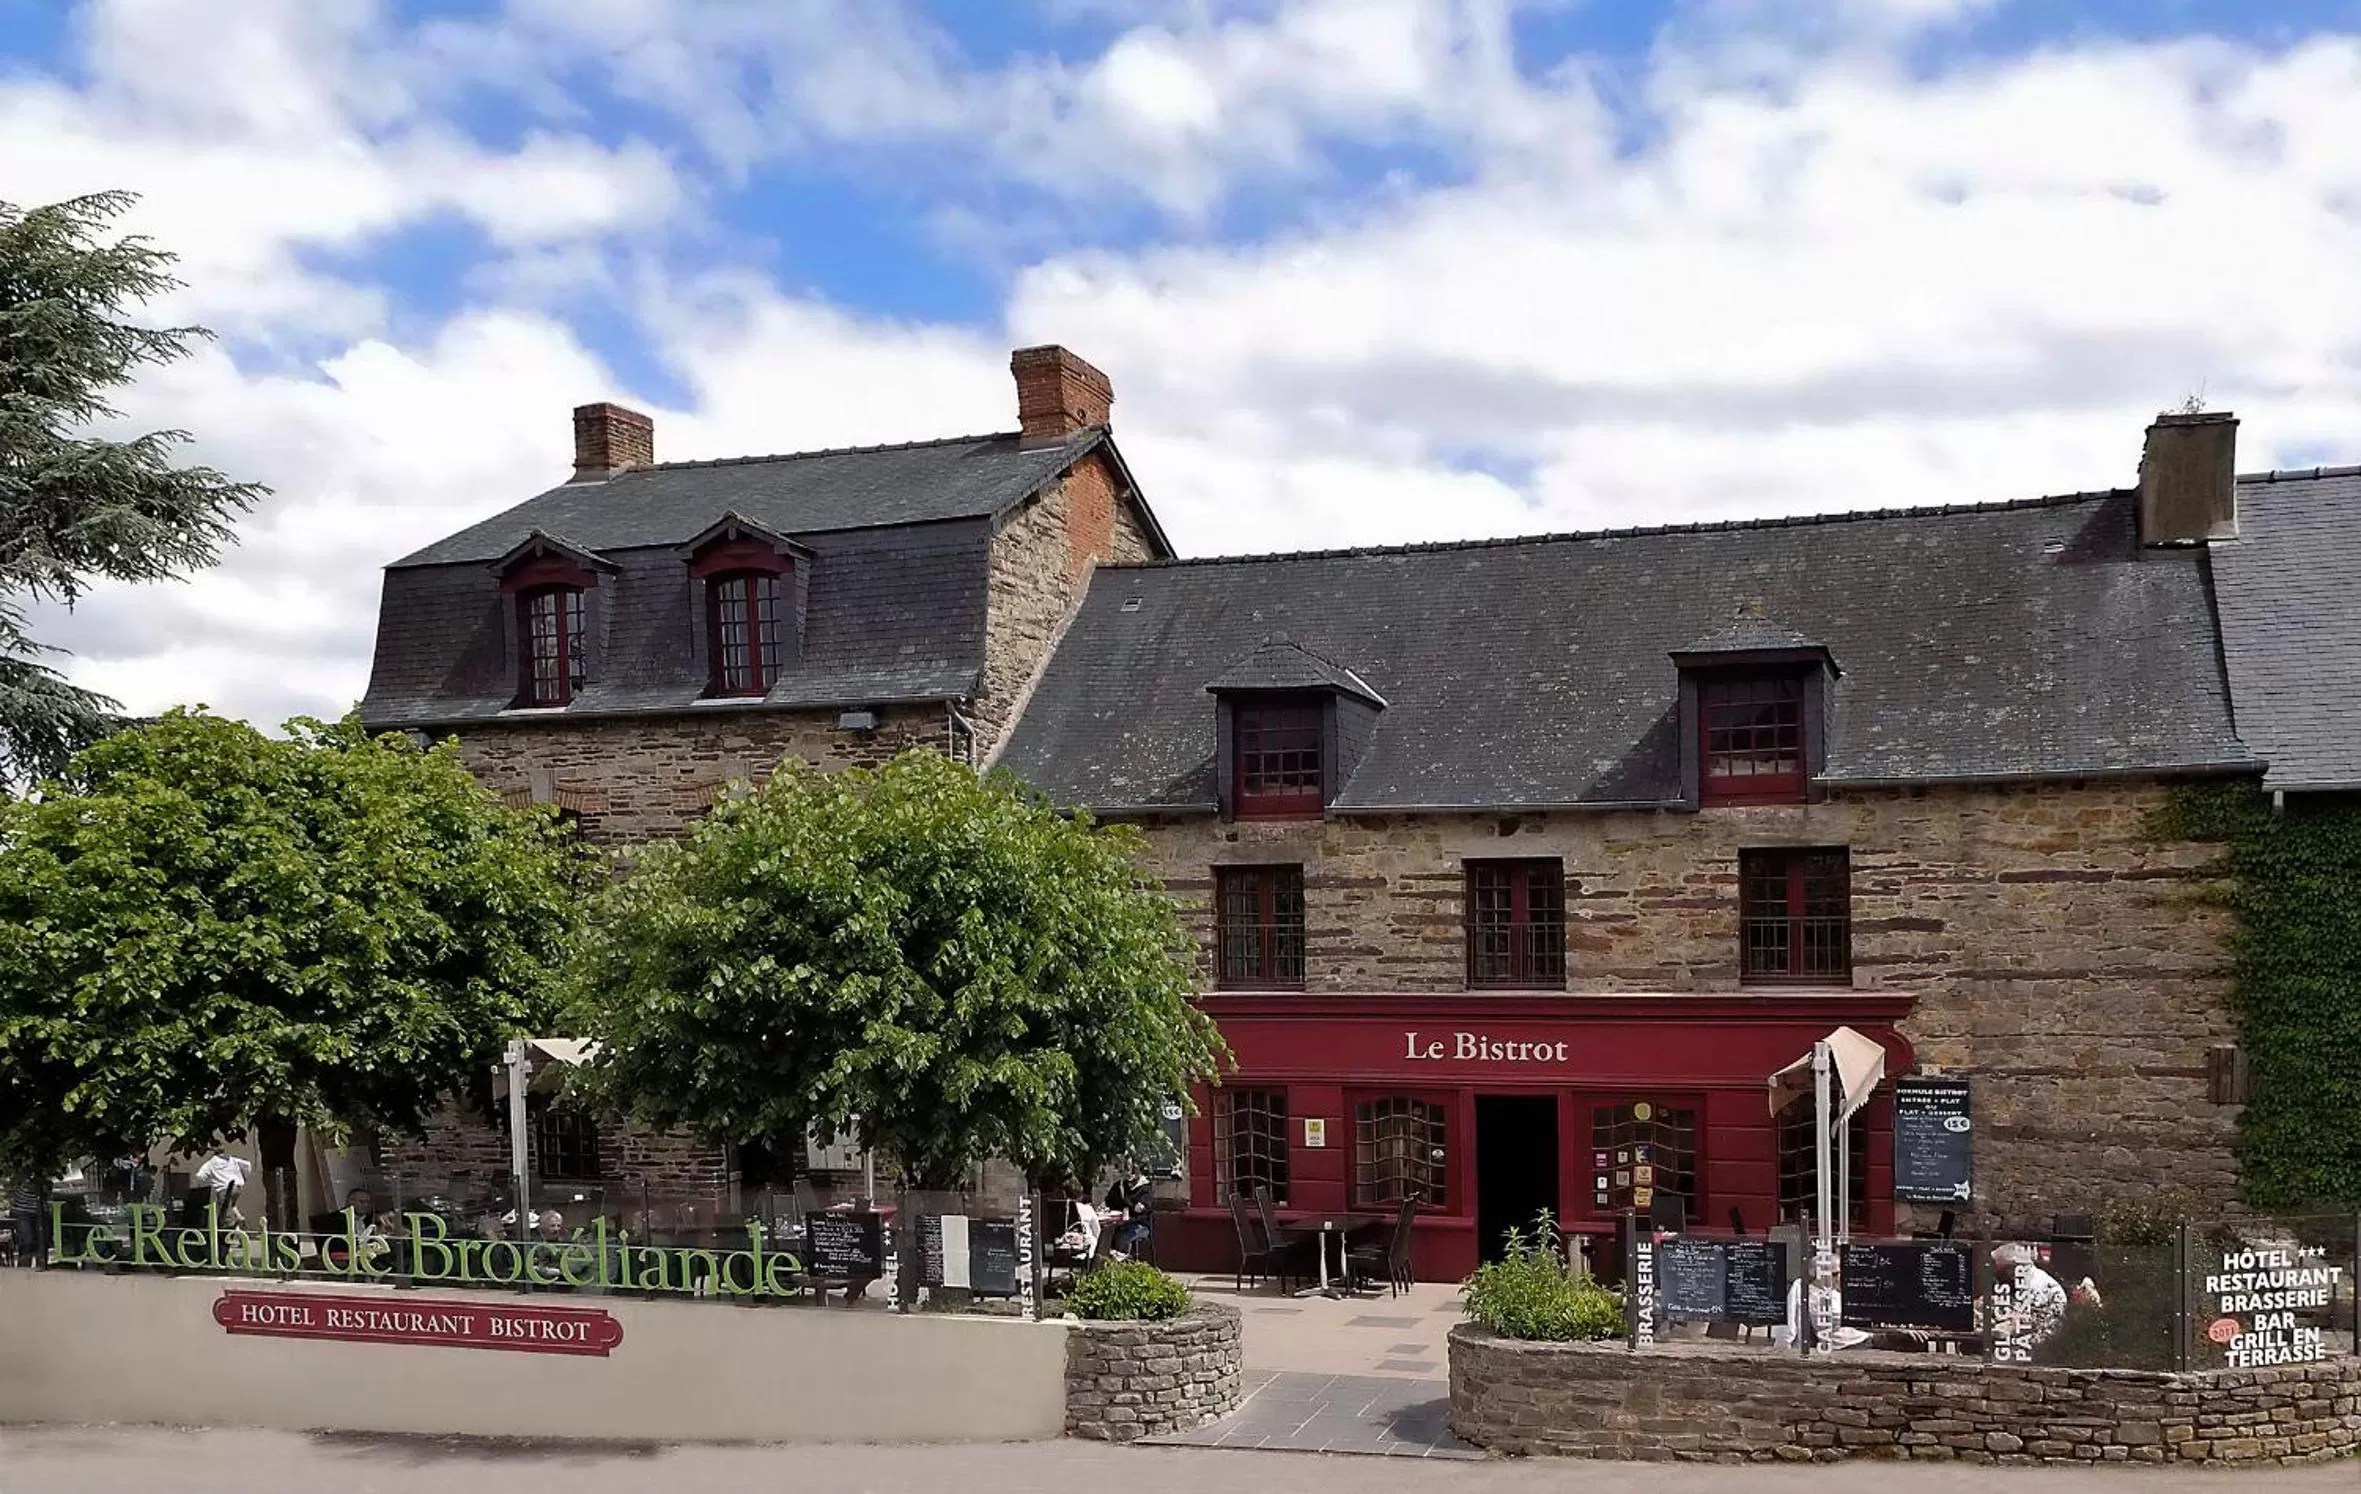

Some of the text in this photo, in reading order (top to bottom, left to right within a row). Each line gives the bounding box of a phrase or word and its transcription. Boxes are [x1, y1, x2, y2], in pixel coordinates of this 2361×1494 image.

[1404, 1032, 1569, 1062] Le Bistrot
[48, 1201, 118, 1264] Le
[127, 1202, 302, 1274] Relais
[321, 1206, 394, 1277] de
[403, 1211, 802, 1297] Brocéliande
[1019, 1195, 1035, 1320] RESTAURANT
[2223, 1247, 2293, 1271] HÔTEL
[2206, 1267, 2343, 1293] RESTAURANT
[1637, 1241, 1654, 1348] BRASSERIE
[2221, 1289, 2329, 1313] BRASSERIE
[241, 1304, 592, 1342] HOTEL RESTAURANT BISTROT
[1993, 1283, 2011, 1361] GLACES
[2254, 1312, 2296, 1332] BAR
[2230, 1327, 2320, 1351] GRILL EN
[2224, 1343, 2327, 1368] TERRASSE
